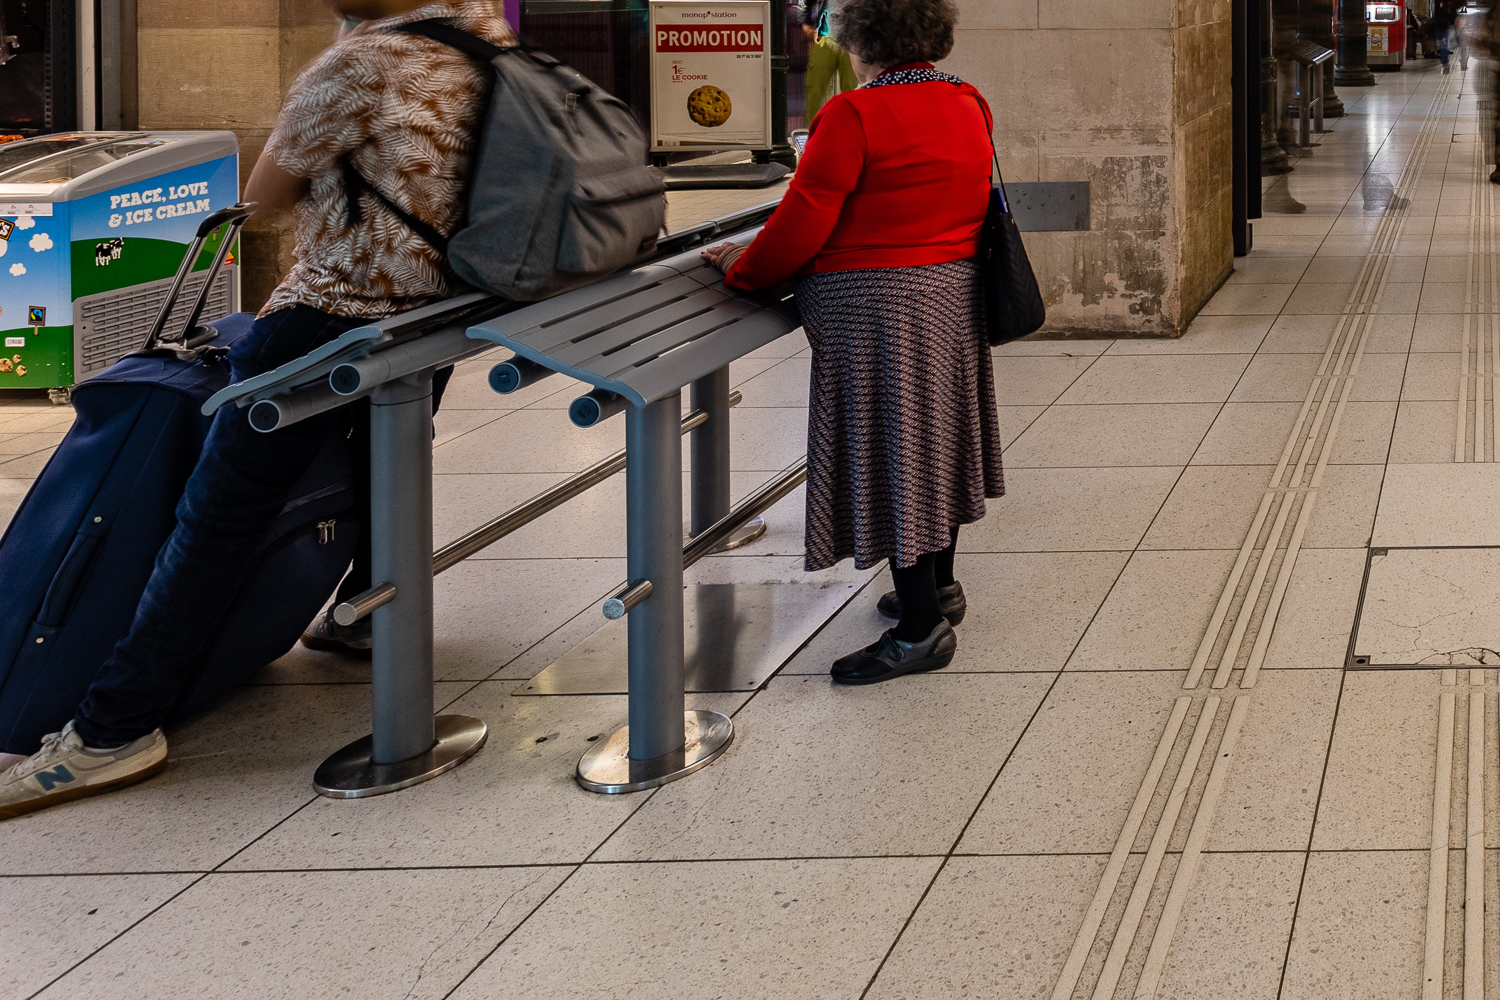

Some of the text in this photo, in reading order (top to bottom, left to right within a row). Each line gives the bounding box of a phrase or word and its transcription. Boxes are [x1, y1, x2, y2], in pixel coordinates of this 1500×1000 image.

[681, 11, 737, 19] monop'station
[657, 30, 762, 47] PROMOTION
[110, 182, 208, 210] PEACE, LOVE
[108, 199, 210, 228] & ICE CREAM
